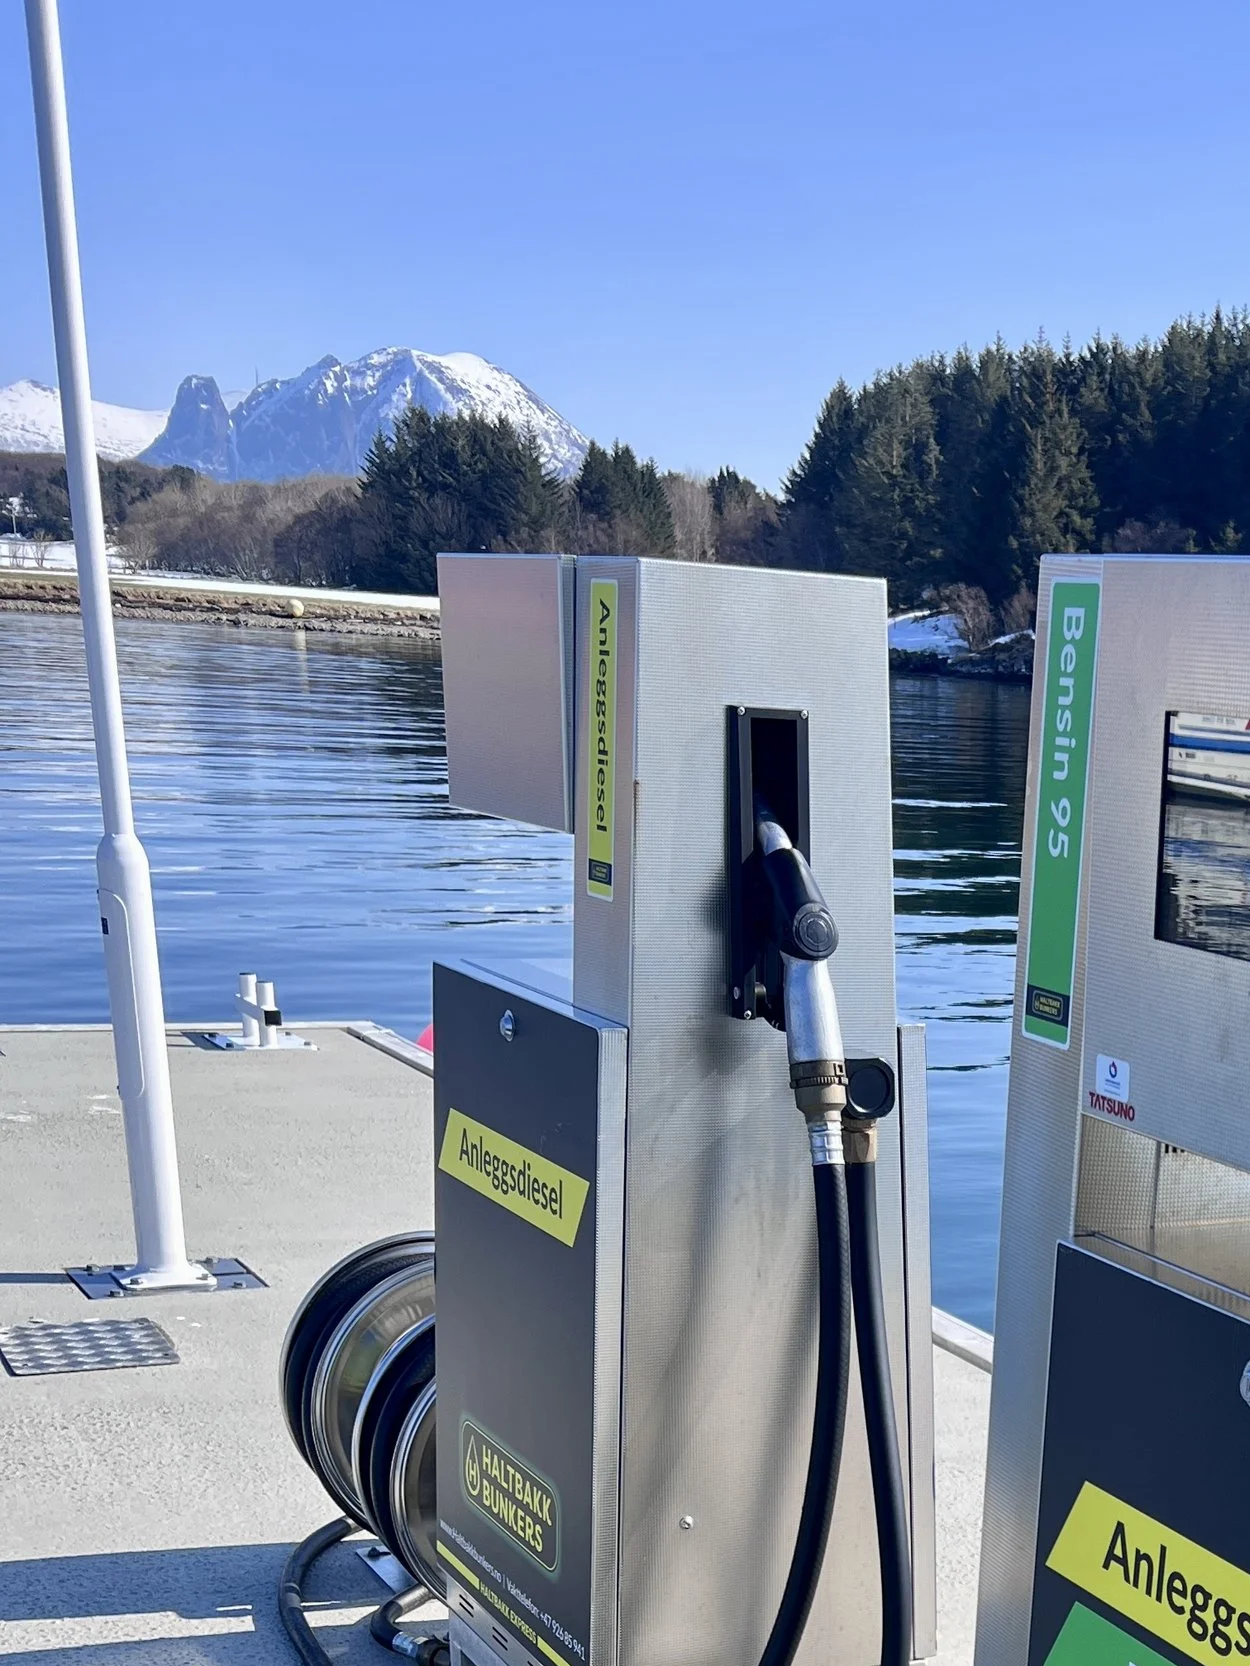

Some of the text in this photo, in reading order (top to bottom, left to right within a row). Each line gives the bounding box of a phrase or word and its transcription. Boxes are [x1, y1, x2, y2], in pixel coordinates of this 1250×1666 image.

[595, 597, 611, 833] Anleggsdiesel
[1048, 607, 1086, 859] Bensin 95
[1089, 1091, 1135, 1122] TATSUNO
[459, 1127, 562, 1219] Anleggsdiesel
[483, 1444, 552, 1526] HALTBAKK
[483, 1478, 543, 1552] BUNKERS
[510, 1610, 537, 1645] EXPRESS
